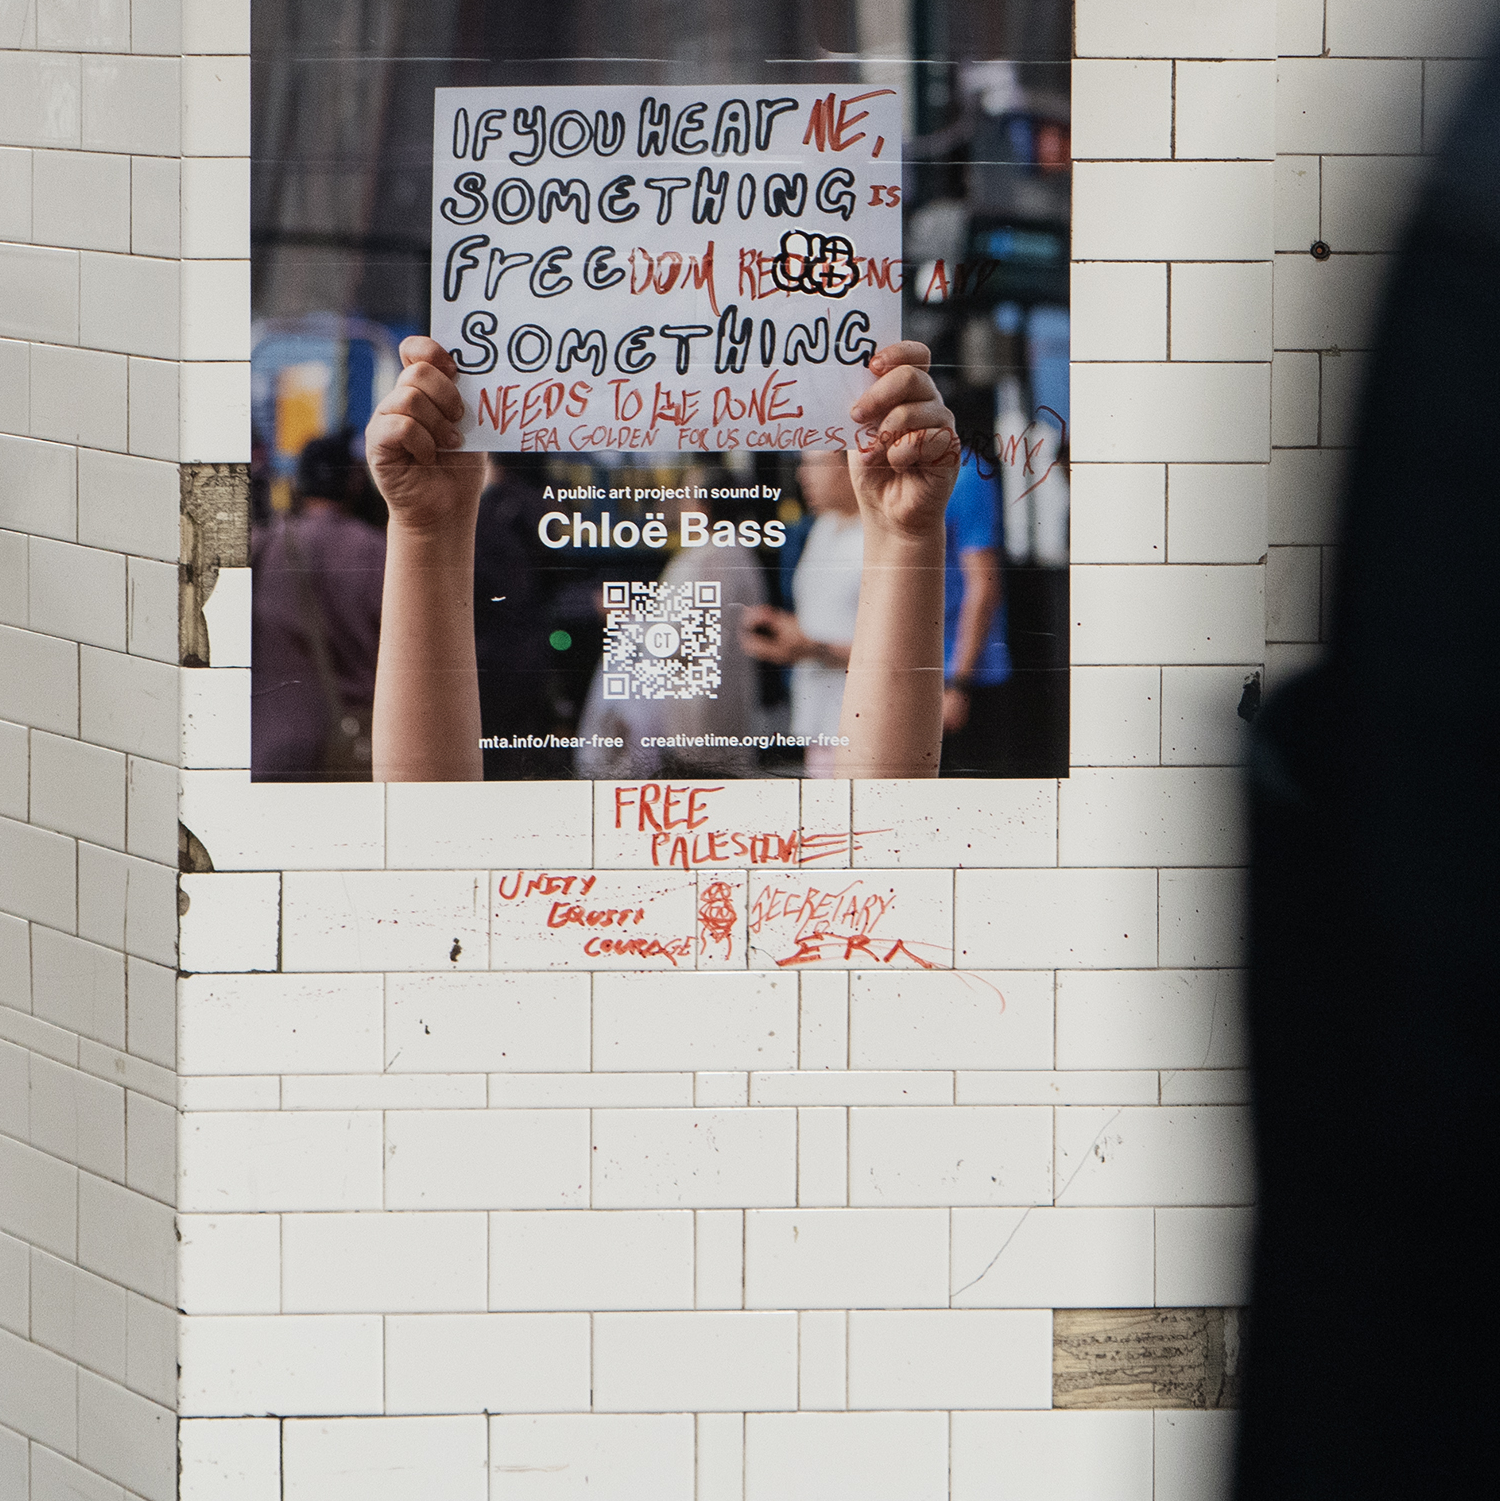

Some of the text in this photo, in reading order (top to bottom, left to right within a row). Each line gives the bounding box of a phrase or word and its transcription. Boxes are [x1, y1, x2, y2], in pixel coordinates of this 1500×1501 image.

[440, 166, 902, 226] SOMETHING IS
[450, 305, 877, 375] SOMETHING
[478, 378, 593, 435] NEEDS
[608, 379, 643, 422] TO
[520, 427, 561, 452] ERA
[569, 423, 660, 451] GOLDEN
[678, 427, 709, 451] FOR
[716, 428, 741, 450] US
[746, 424, 848, 453] CONGRESS
[543, 485, 781, 503] A public art project in sound by
[538, 510, 786, 548] Chloë Bass
[653, 631, 672, 649] CT
[478, 732, 850, 750] mta.info/hear-free creativetime.org/hear-free
[615, 784, 725, 832] FREE
[499, 871, 597, 900] UNITY
